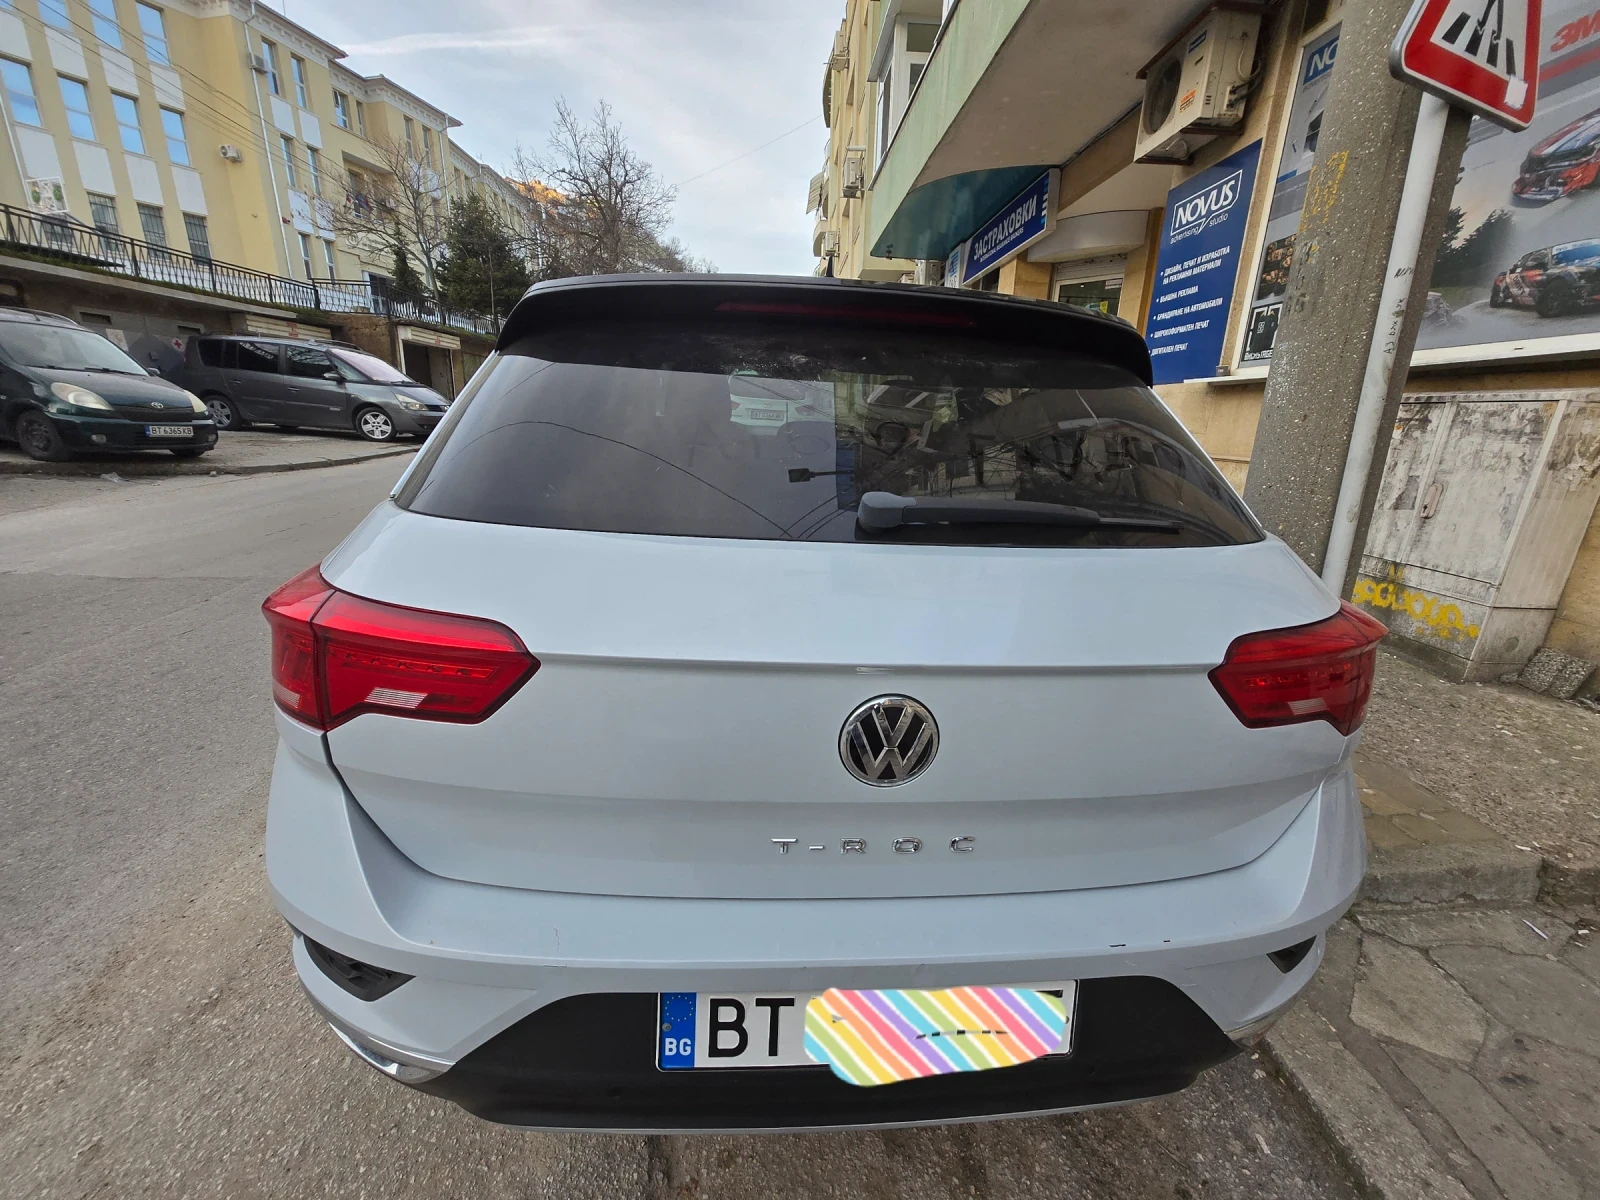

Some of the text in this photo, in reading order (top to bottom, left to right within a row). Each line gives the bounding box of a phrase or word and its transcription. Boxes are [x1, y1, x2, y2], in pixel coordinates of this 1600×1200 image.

[1175, 180, 1235, 228] NOVUS
[974, 194, 1037, 260] ЗАСТРАХОВКИ
[1170, 213, 1228, 244] advertising studio
[1178, 285, 1199, 298] РЕКЛАМА
[1157, 308, 1183, 321] БРАНДИРАНЕ
[1190, 298, 1223, 312] АВТОМОБИЛИ
[1154, 320, 1210, 338] ШИРОКОФОРМАТЕН ПЕЧАТ
[1174, 343, 1188, 351] ПЕЧАТ
[151, 427, 192, 435] BT 6365 KB
[770, 836, 975, 854] T-ROC
[707, 997, 795, 1058] BT
[665, 1037, 692, 1056] BG
